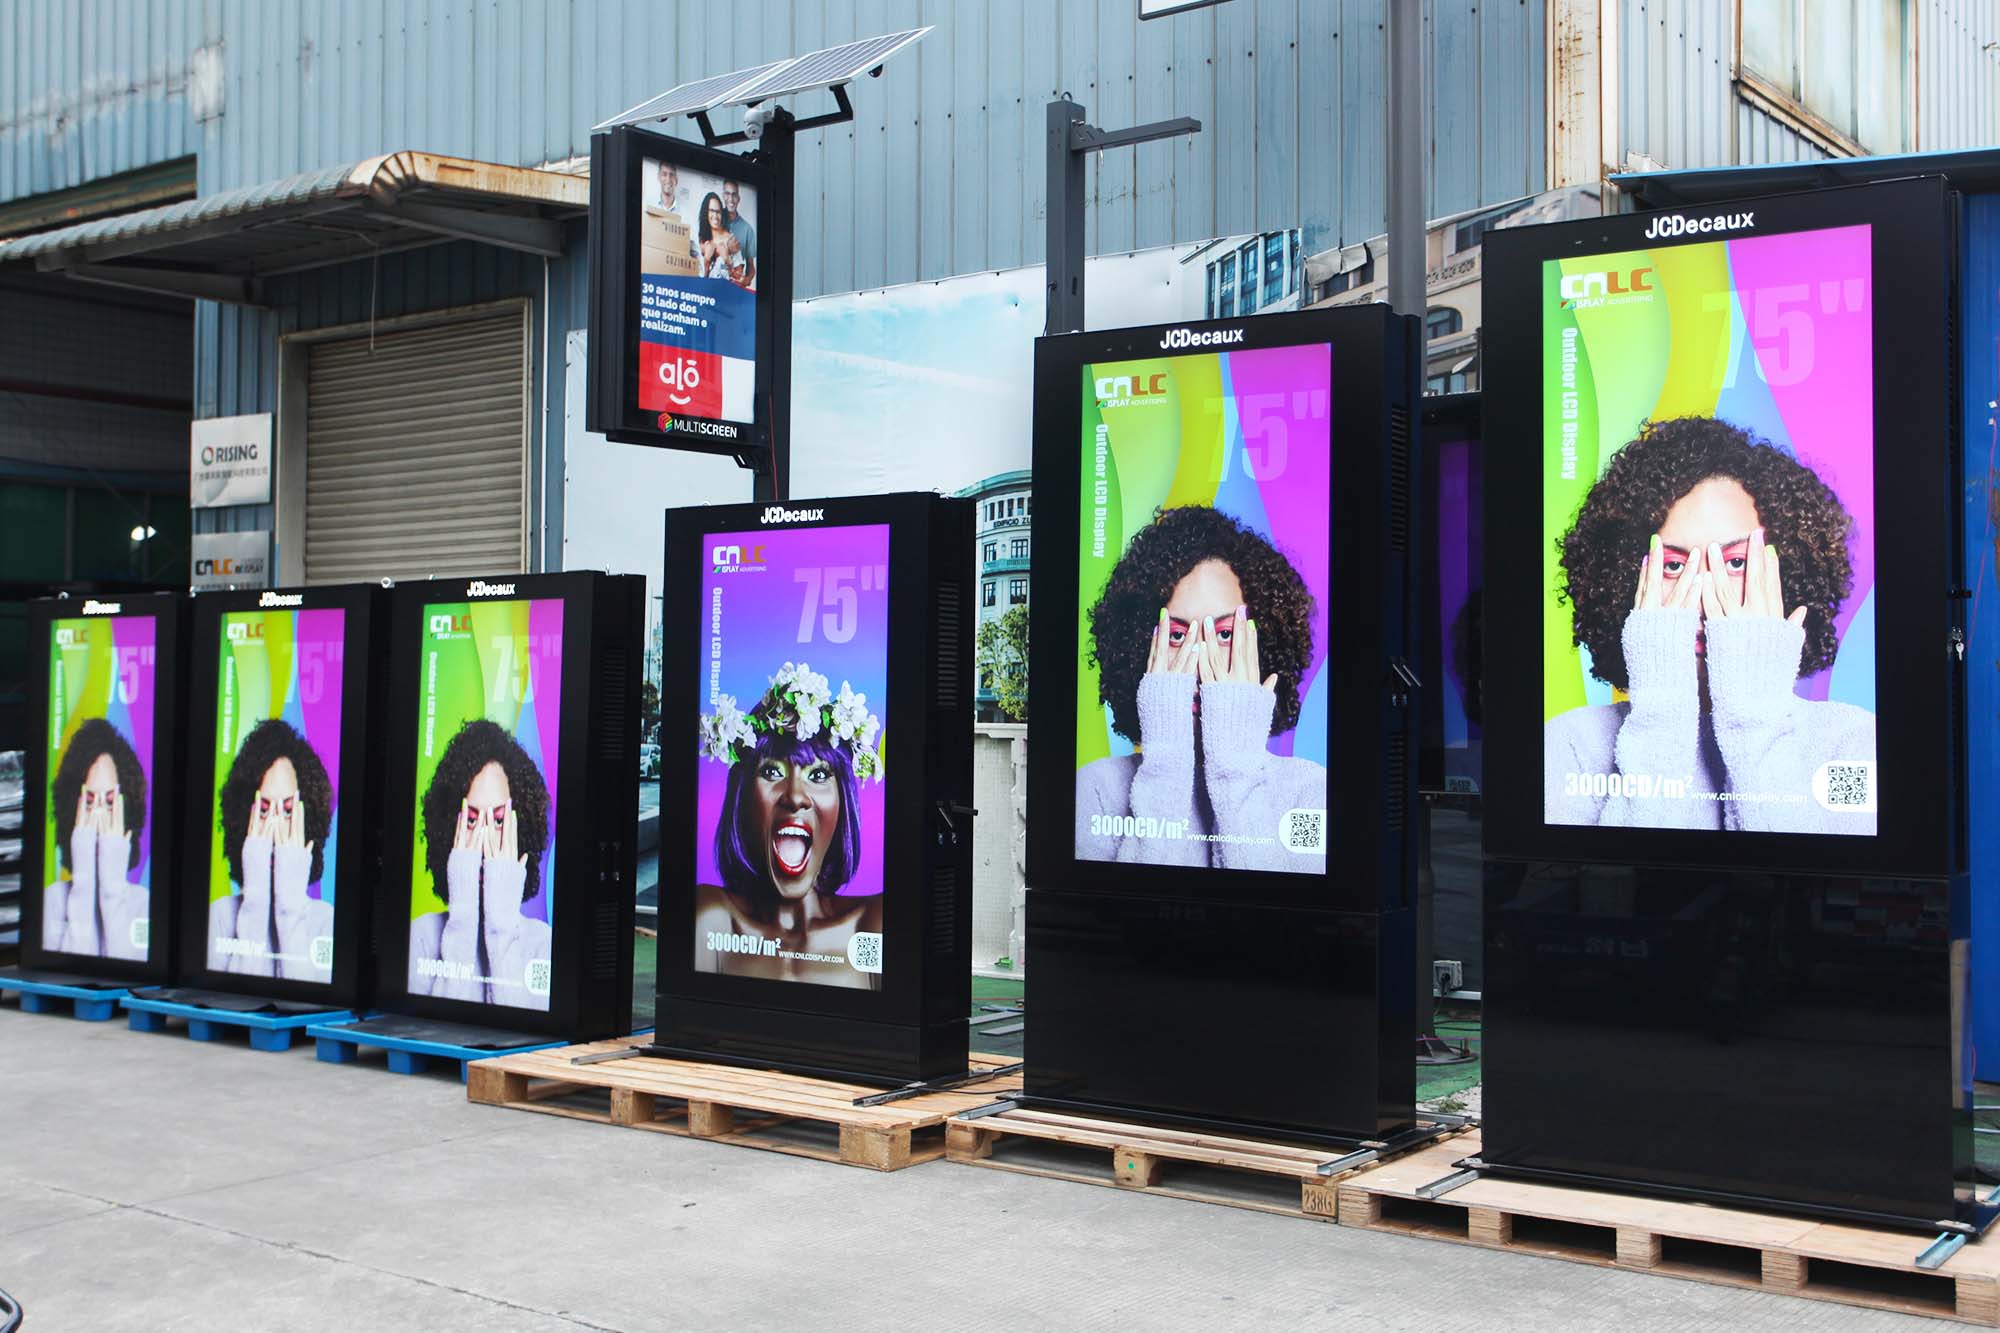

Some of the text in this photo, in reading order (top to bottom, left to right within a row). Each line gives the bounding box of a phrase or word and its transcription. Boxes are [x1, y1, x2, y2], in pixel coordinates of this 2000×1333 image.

[1645, 212, 1754, 238] JCDecaux
[641, 295, 697, 314] ao lado dos
[642, 282, 716, 307] 30 anos sempre
[641, 307, 708, 328] que sonham e
[641, 319, 686, 336] realizam.
[1160, 328, 1244, 349] JCDecaux
[1561, 327, 1578, 480] Outdoor LCD Display
[674, 418, 737, 438] MULTISCREEN
[215, 445, 258, 463] RISING
[1093, 423, 1109, 558] Outdoor LCD Display
[760, 506, 824, 524] JCDecaux
[467, 581, 515, 597] JCDecaux
[712, 587, 723, 635] Outdoor
[794, 564, 887, 644] 75"
[711, 636, 722, 658] LCD
